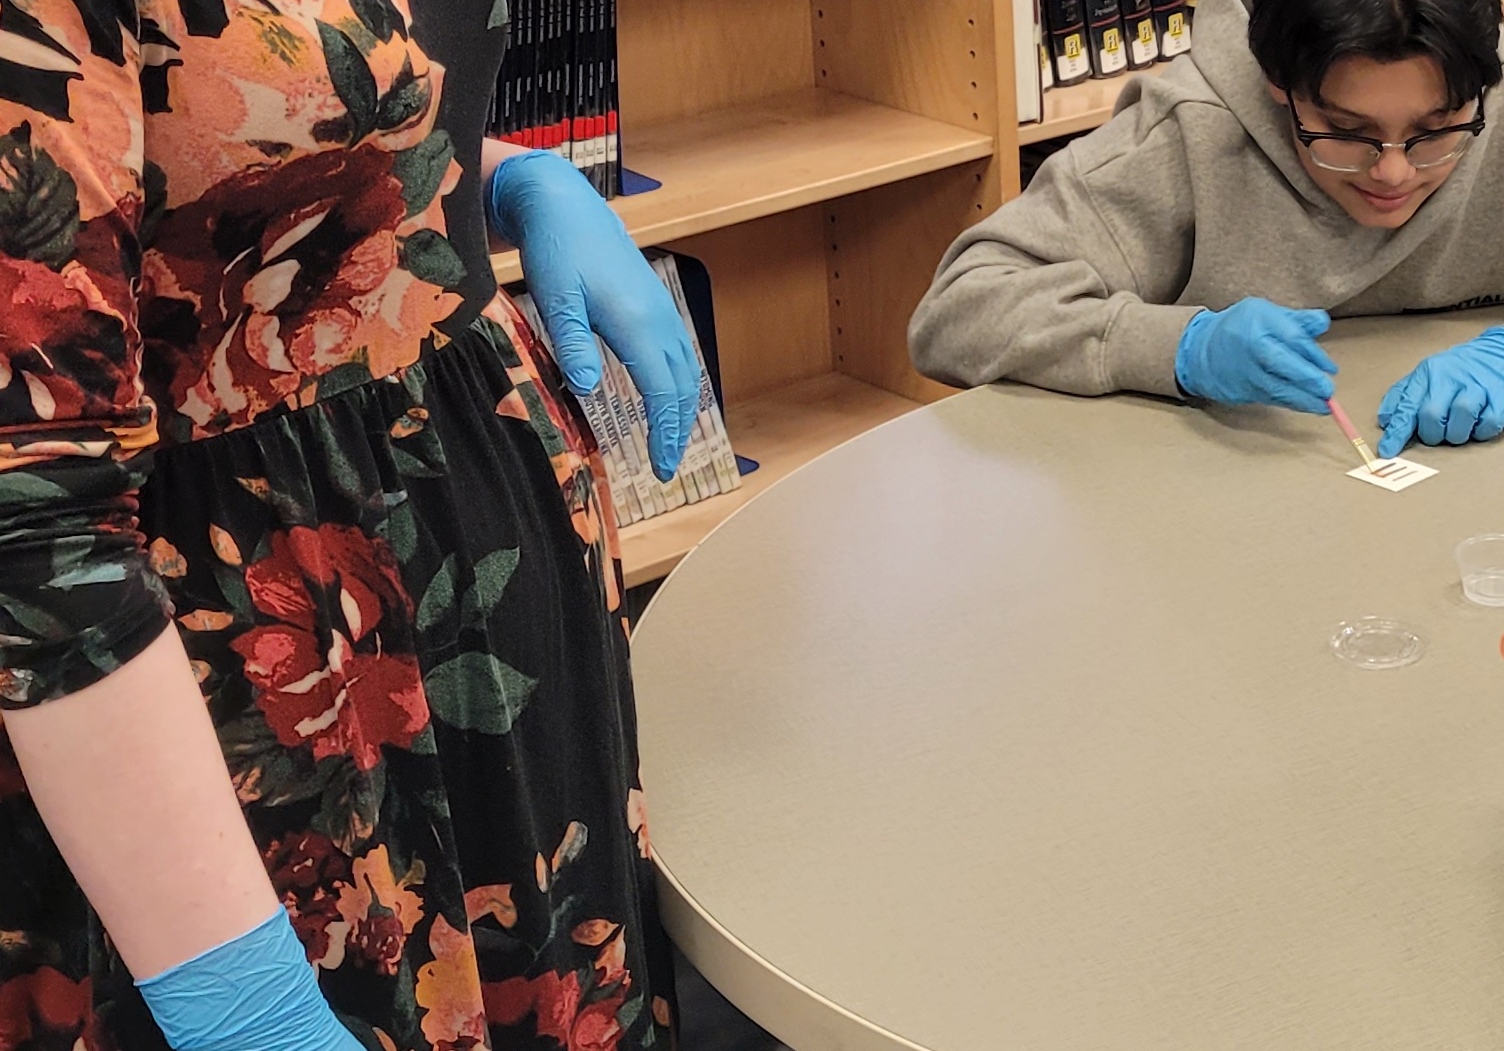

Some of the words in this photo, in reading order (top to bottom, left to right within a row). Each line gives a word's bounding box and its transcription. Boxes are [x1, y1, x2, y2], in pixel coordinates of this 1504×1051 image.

[609, 393, 631, 439] TENNESSEE
[623, 398, 639, 425] TEXAS
[603, 417, 618, 448] DAKOTA
